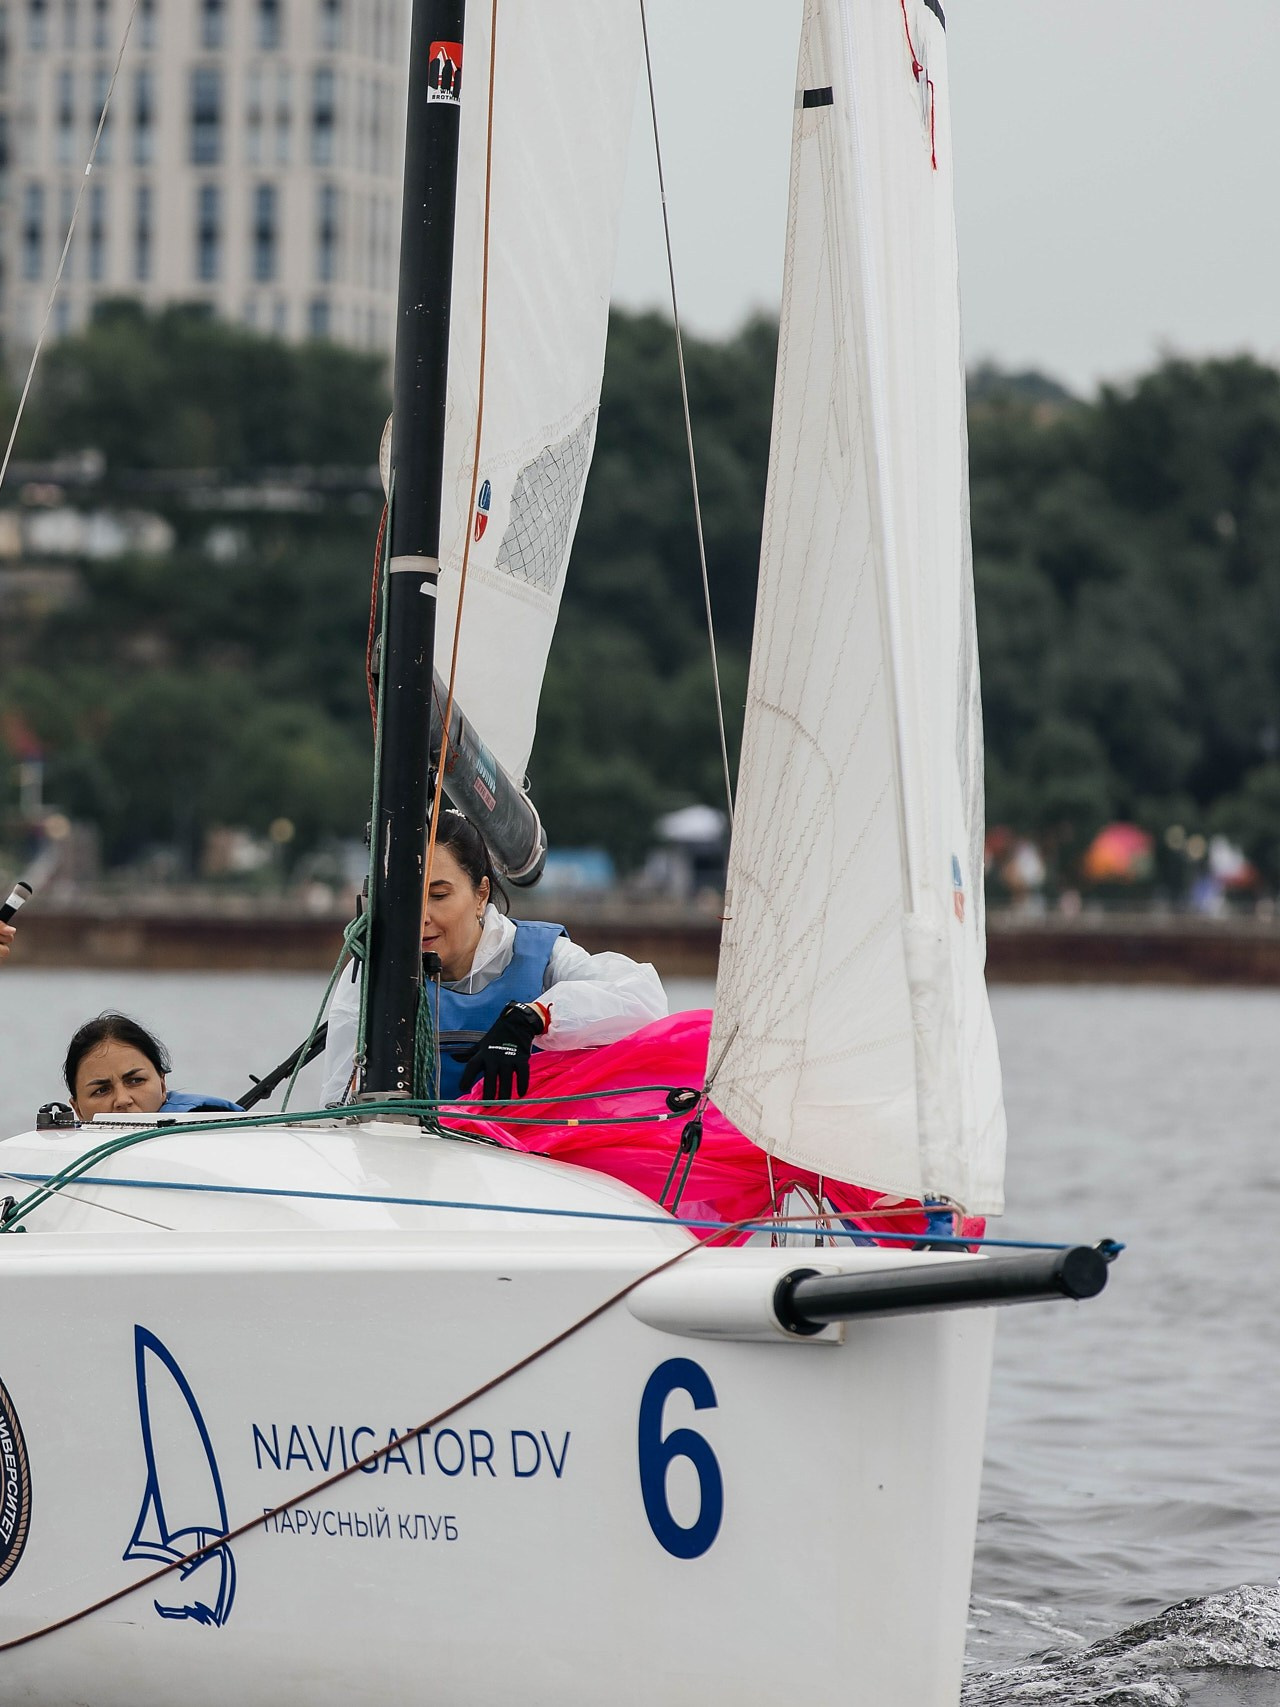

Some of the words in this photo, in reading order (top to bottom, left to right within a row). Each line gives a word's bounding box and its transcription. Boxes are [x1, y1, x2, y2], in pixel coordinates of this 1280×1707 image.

[252, 1423, 497, 1477] NAVIGATOR
[511, 1430, 571, 1479] DV
[638, 1357, 725, 1560] 6
[263, 1506, 392, 1539] ПАРУСНЫЙ
[398, 1514, 459, 1541] КЛУБ
